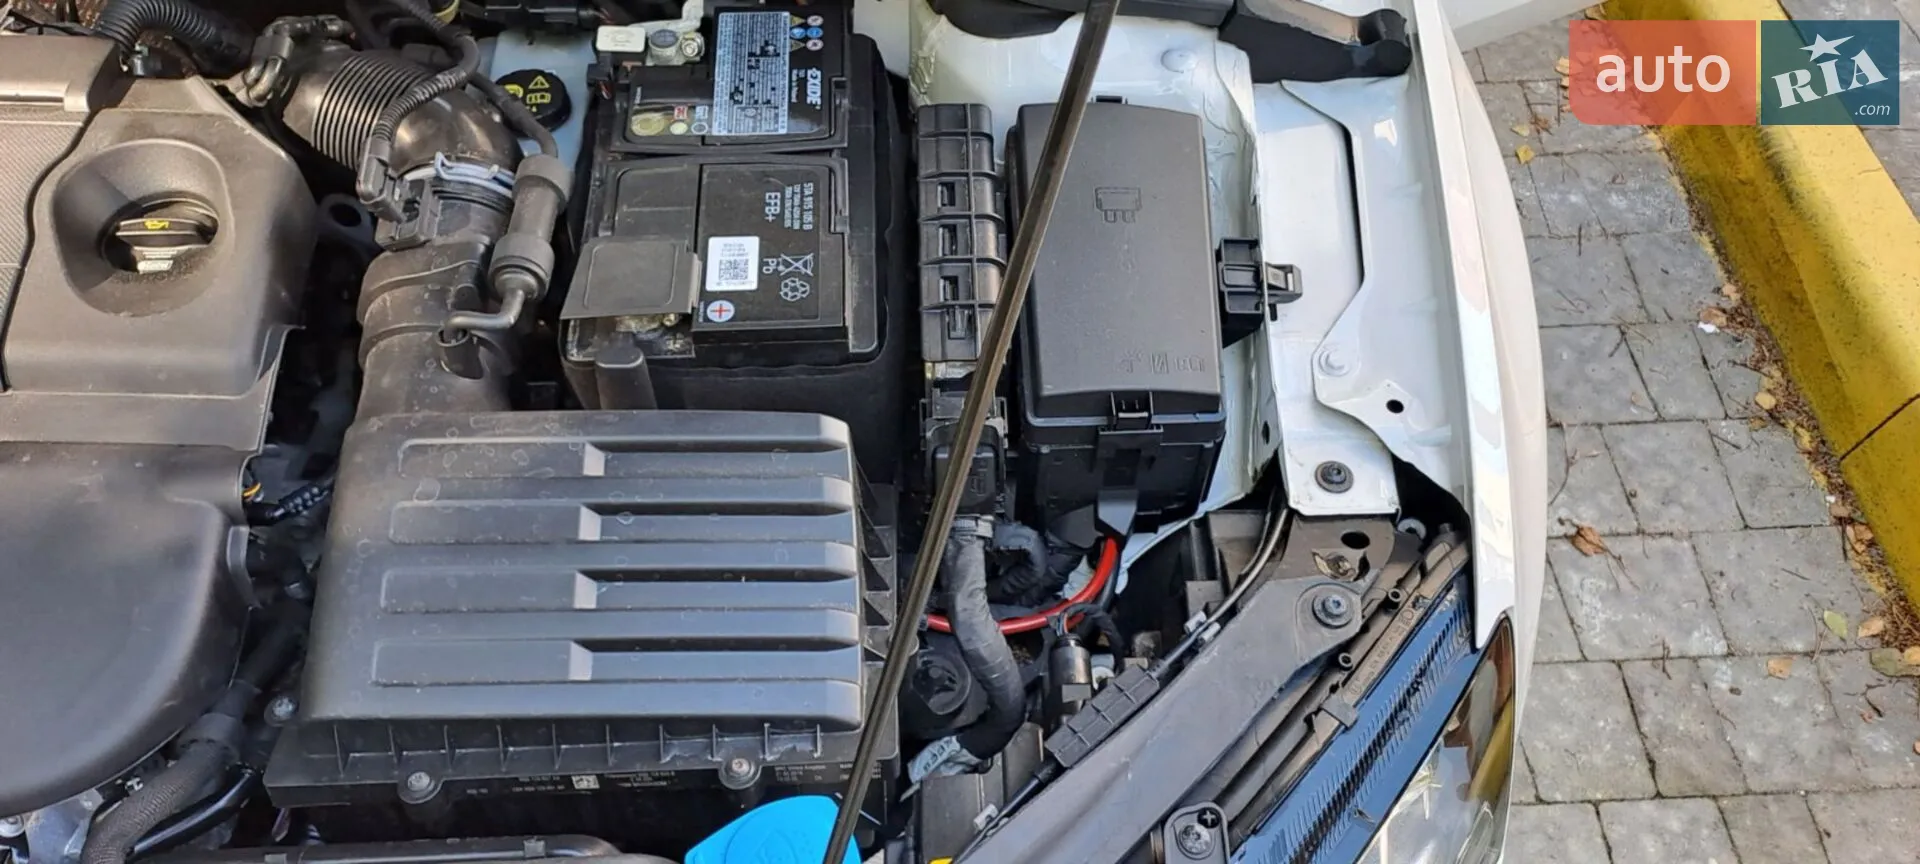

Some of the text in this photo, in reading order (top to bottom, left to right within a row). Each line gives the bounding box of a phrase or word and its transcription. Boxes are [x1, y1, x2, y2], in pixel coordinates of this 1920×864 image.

[806, 67, 822, 105] EXIDE
[764, 191, 781, 223] EFB+
[762, 258, 778, 274] Pb
